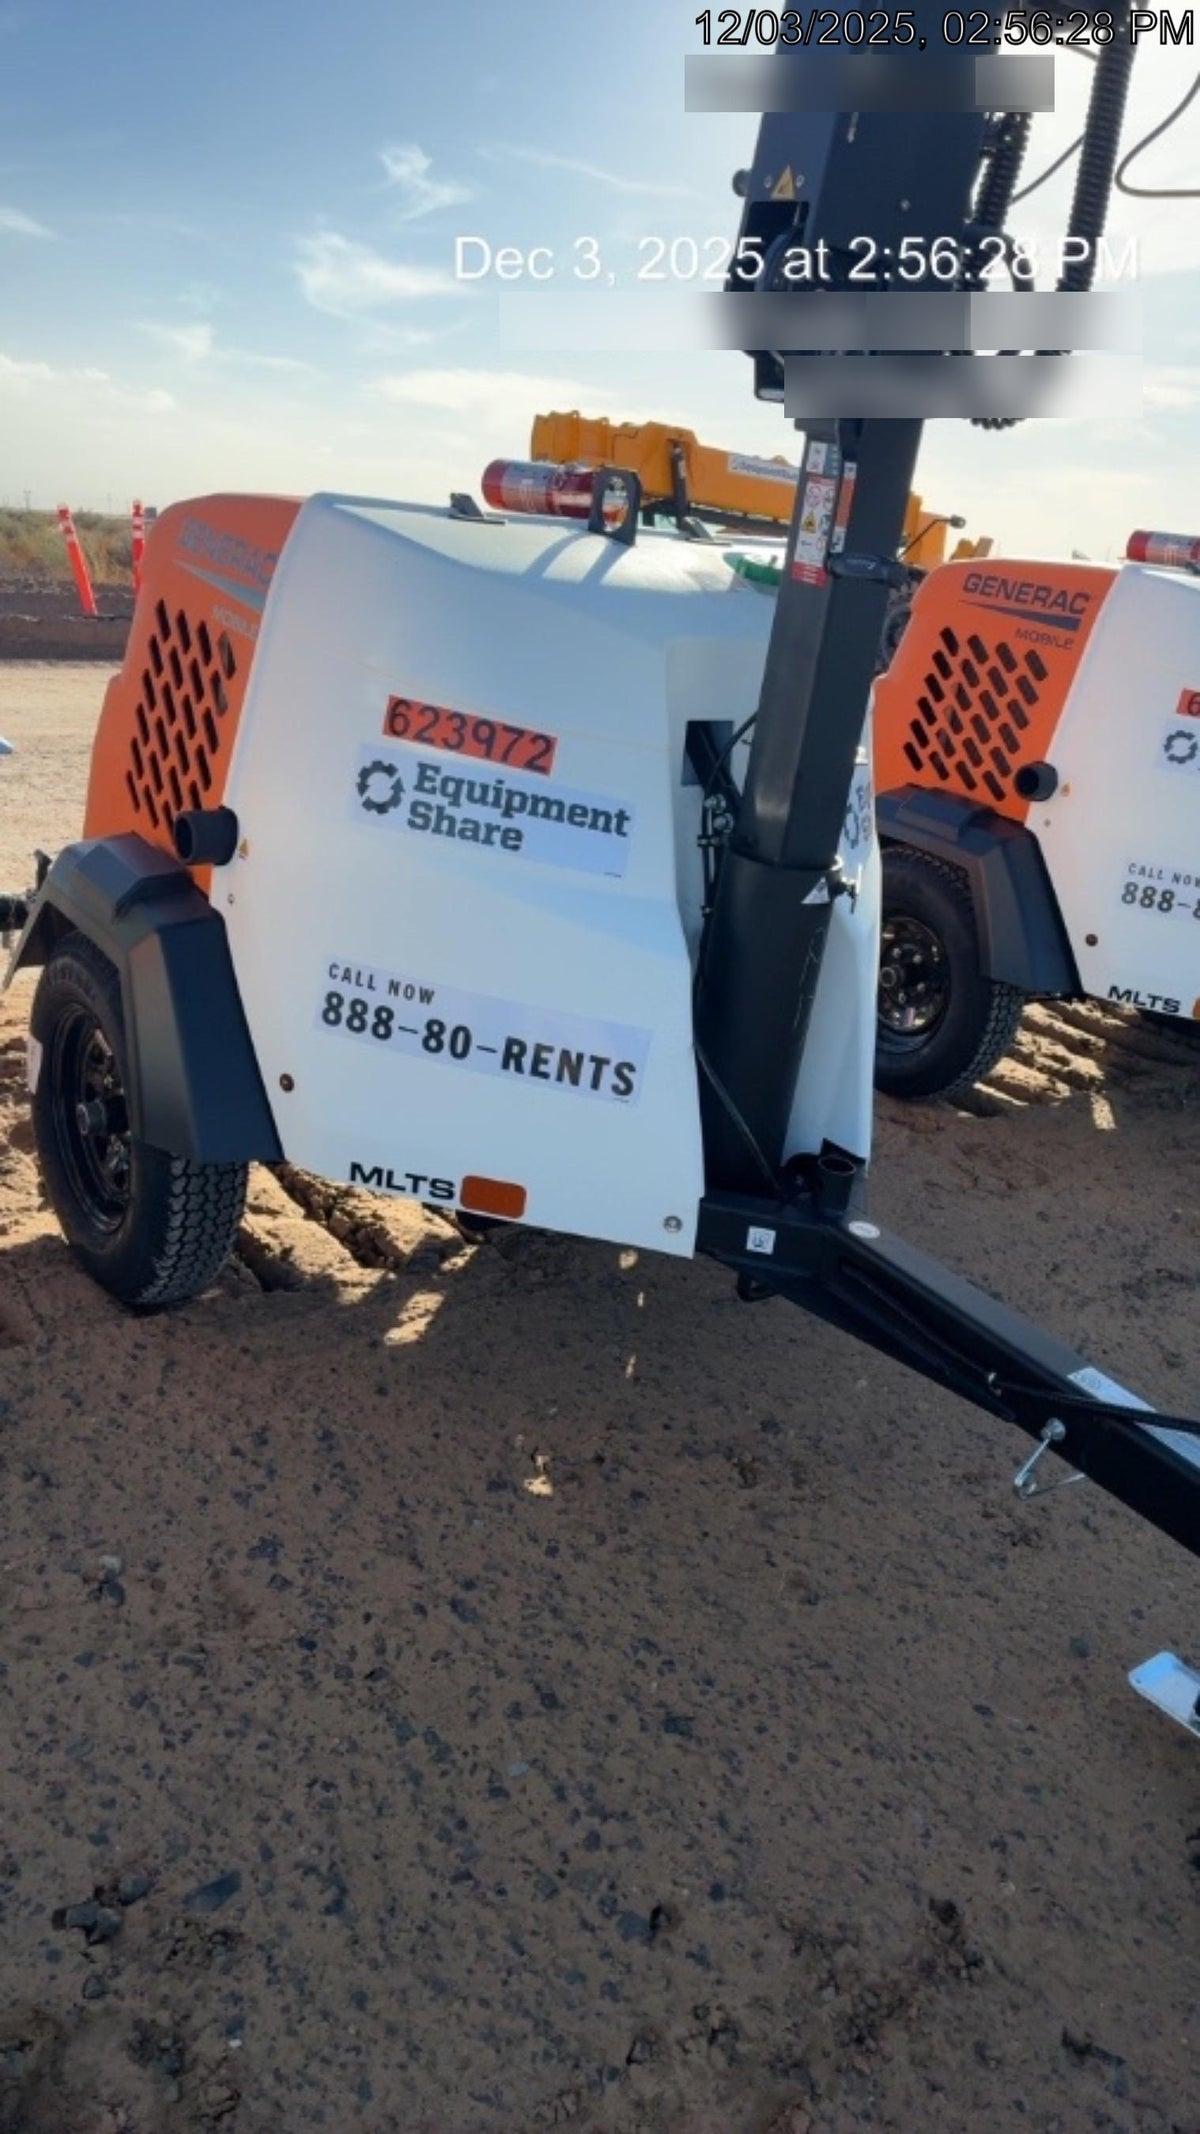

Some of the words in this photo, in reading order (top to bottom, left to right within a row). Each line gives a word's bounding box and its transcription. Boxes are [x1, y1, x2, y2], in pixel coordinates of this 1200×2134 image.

[962, 573, 1090, 615] GENERAC
[1014, 627, 1075, 650] MOBILE
[387, 698, 554, 775] 623972
[412, 761, 631, 838] Equipment
[406, 799, 524, 852] Share
[1128, 862, 1165, 881] CALL
[328, 962, 377, 992] CALL
[387, 978, 436, 1006] NOW
[1107, 985, 1181, 1013] MLTS
[321, 990, 637, 1097] 888-80-RENTS
[349, 1161, 456, 1200] MLTS
